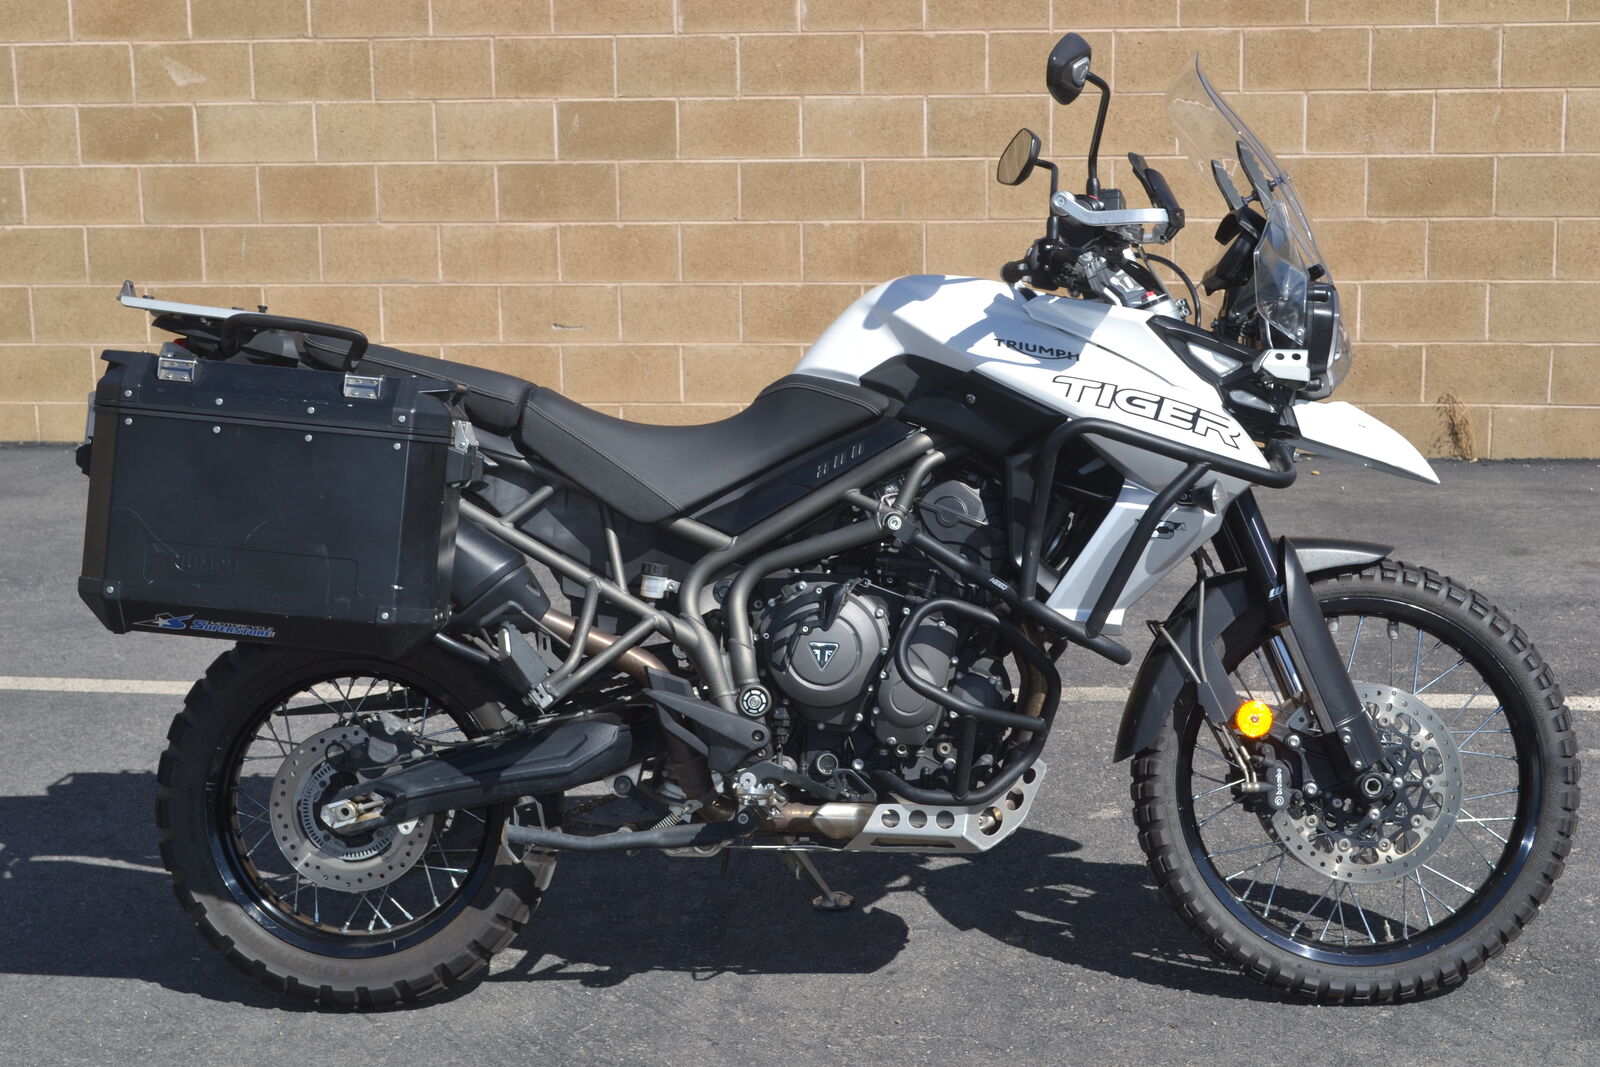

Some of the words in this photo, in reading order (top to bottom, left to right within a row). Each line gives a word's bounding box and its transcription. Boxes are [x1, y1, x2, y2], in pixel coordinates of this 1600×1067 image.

[994, 337, 1080, 361] TRIUMPH
[1052, 375, 1240, 450] TIGER
[190, 619, 273, 638] SUPERSTORE
[209, 620, 275, 631] MOTORCYCLE
[1275, 768, 1284, 796] brembo
